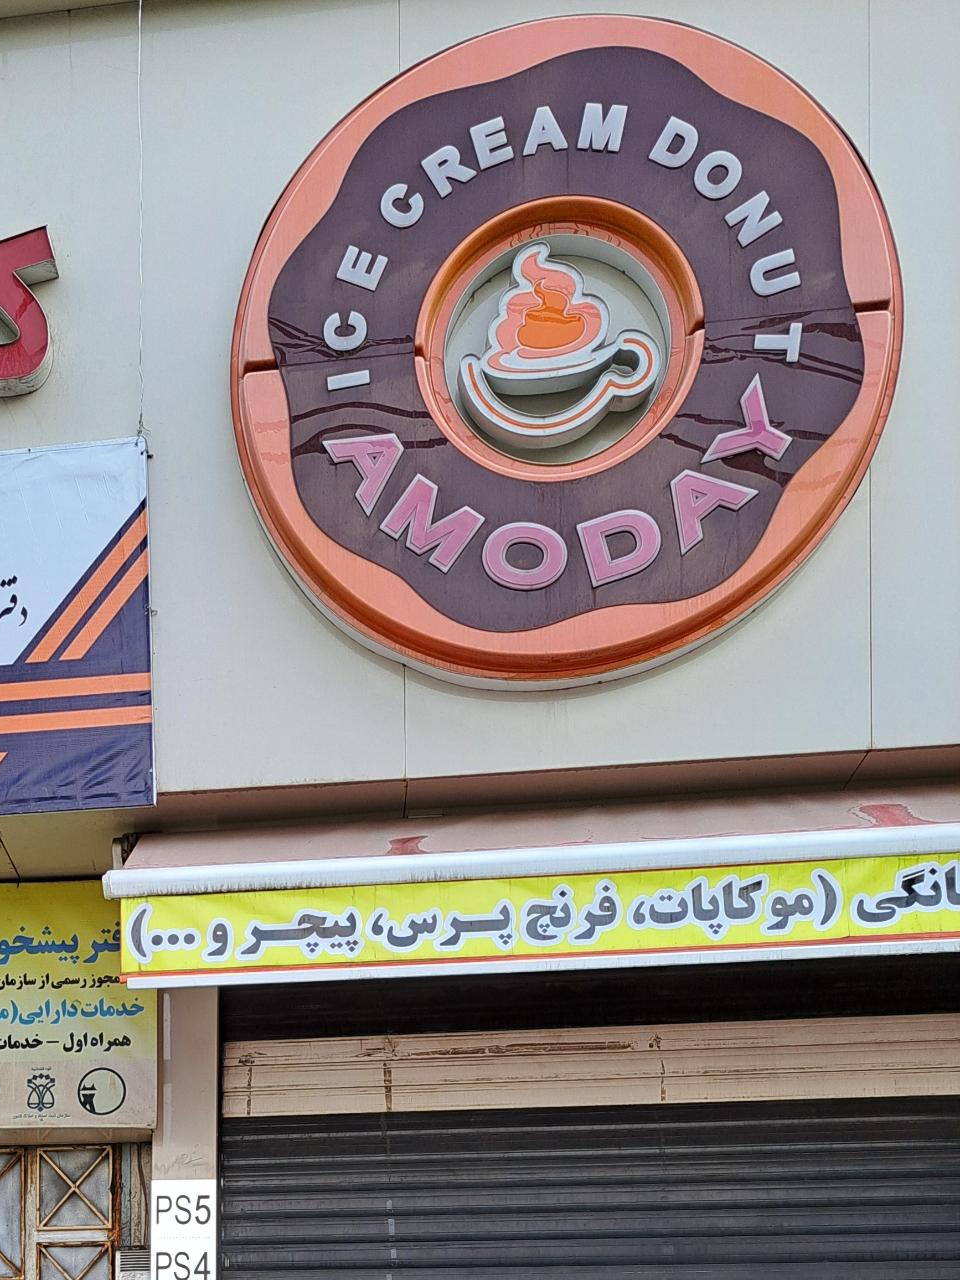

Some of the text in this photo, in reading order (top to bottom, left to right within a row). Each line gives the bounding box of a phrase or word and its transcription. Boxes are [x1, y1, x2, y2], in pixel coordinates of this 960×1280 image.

[323, 102, 803, 392] ICE CREAM DONUT
[322, 372, 793, 591] AMODAY
[856, 866, 960, 923] انگی
[525, 883, 618, 941] فرنچ
[206, 920, 229, 957] و
[240, 909, 358, 955] پیچر
[38, 973, 50, 989] از
[51, 974, 87, 990] رسمی
[80, 997, 145, 1018] خدمات
[63, 1032, 88, 1052] اول
[91, 1032, 132, 1051] همراه
[155, 1195, 211, 1225] PS5
